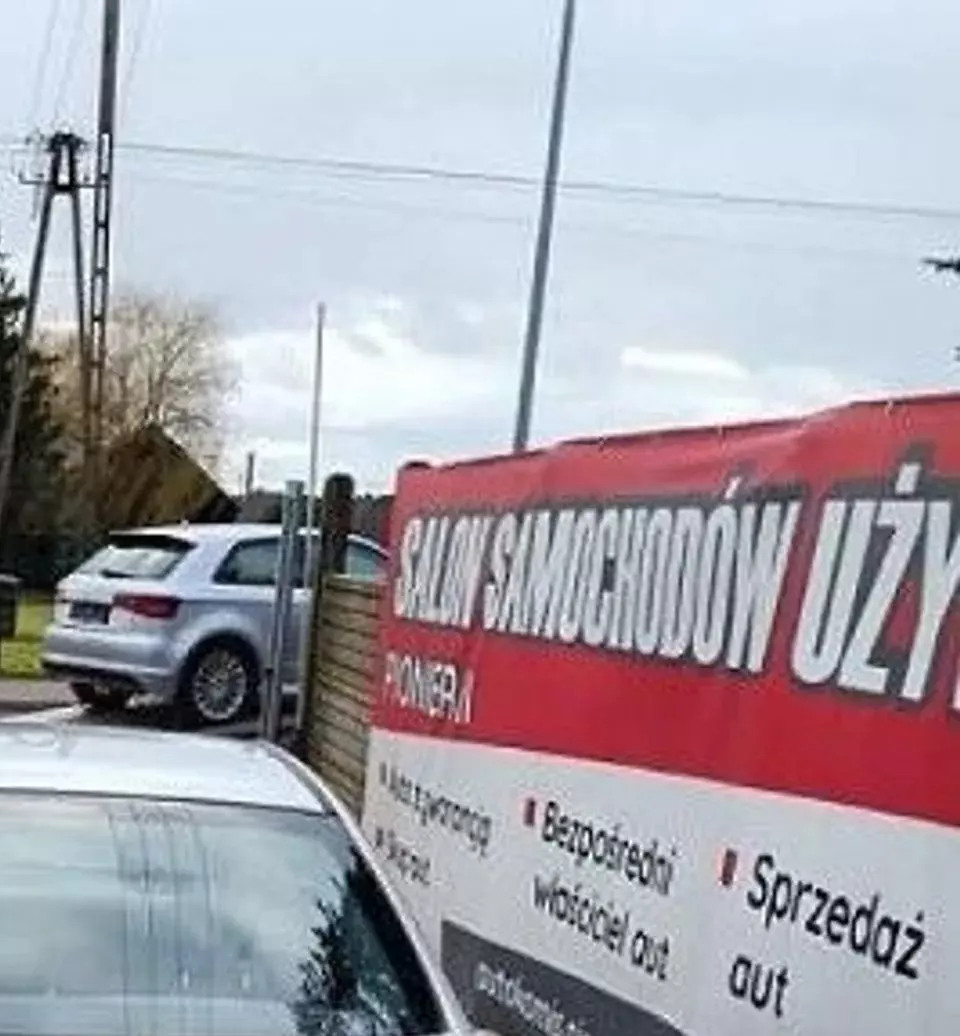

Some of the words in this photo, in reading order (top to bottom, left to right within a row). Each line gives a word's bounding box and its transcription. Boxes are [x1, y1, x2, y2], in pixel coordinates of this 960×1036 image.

[394, 516, 492, 627] SALON
[483, 475, 802, 673] SAMOCHODÓW
[792, 461, 960, 711] UŻY
[542, 800, 679, 895] Bezpośredni
[534, 874, 629, 957] właściciel
[631, 928, 670, 981] aut
[747, 854, 926, 979] Sprzedaż
[729, 954, 789, 1019] aut
